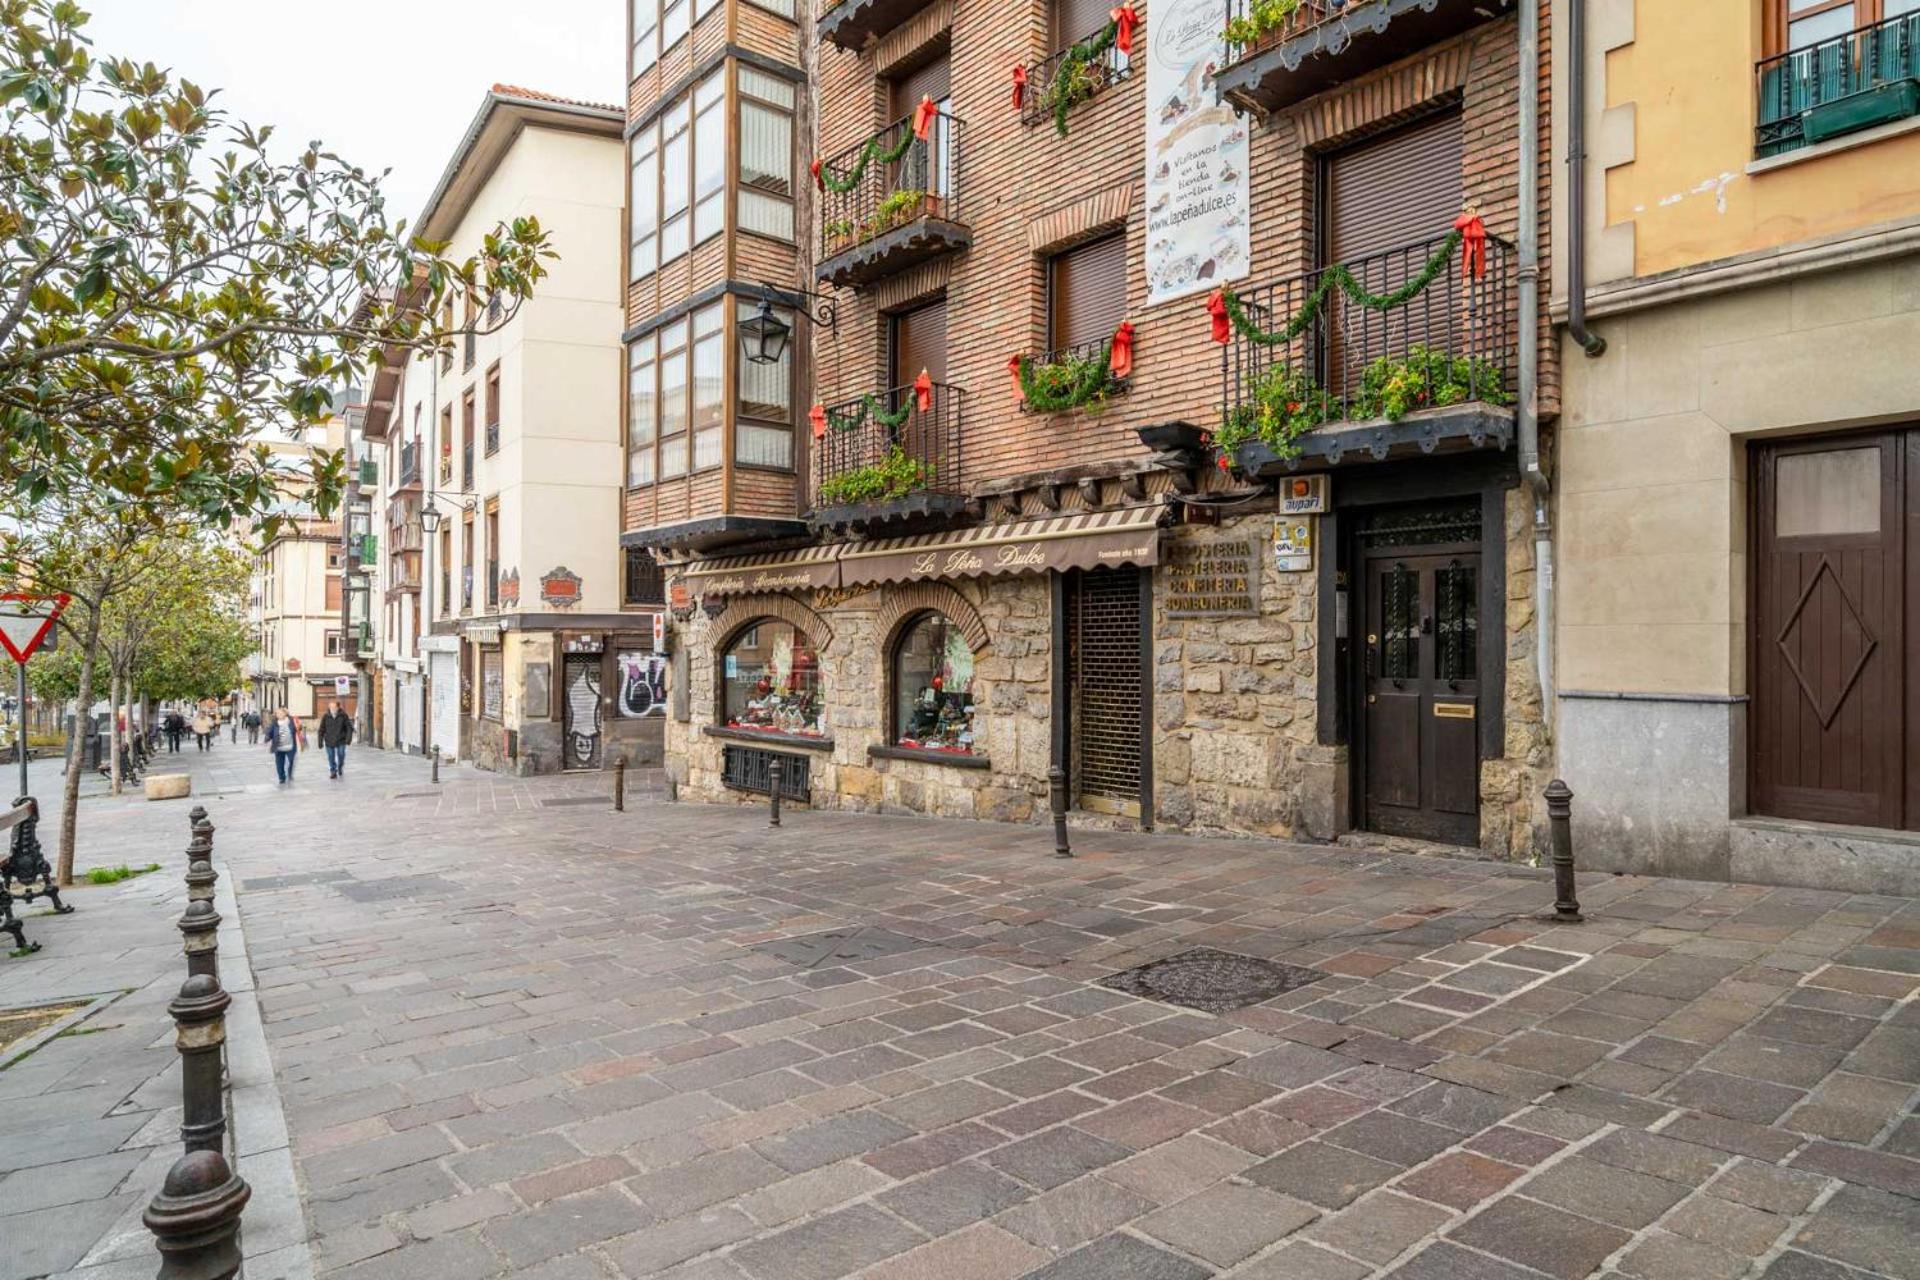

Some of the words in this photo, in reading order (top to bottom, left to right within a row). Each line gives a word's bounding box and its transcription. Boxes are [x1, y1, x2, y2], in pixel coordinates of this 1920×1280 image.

[1181, 166, 1192, 176] en
[1178, 172, 1210, 190] tienda
[1149, 191, 1237, 233] www.lapeñadulce.es
[911, 552, 937, 573] La
[943, 549, 983, 573] Peña
[994, 542, 1046, 567] Dulce
[1168, 576, 1249, 594] CONFITERIA
